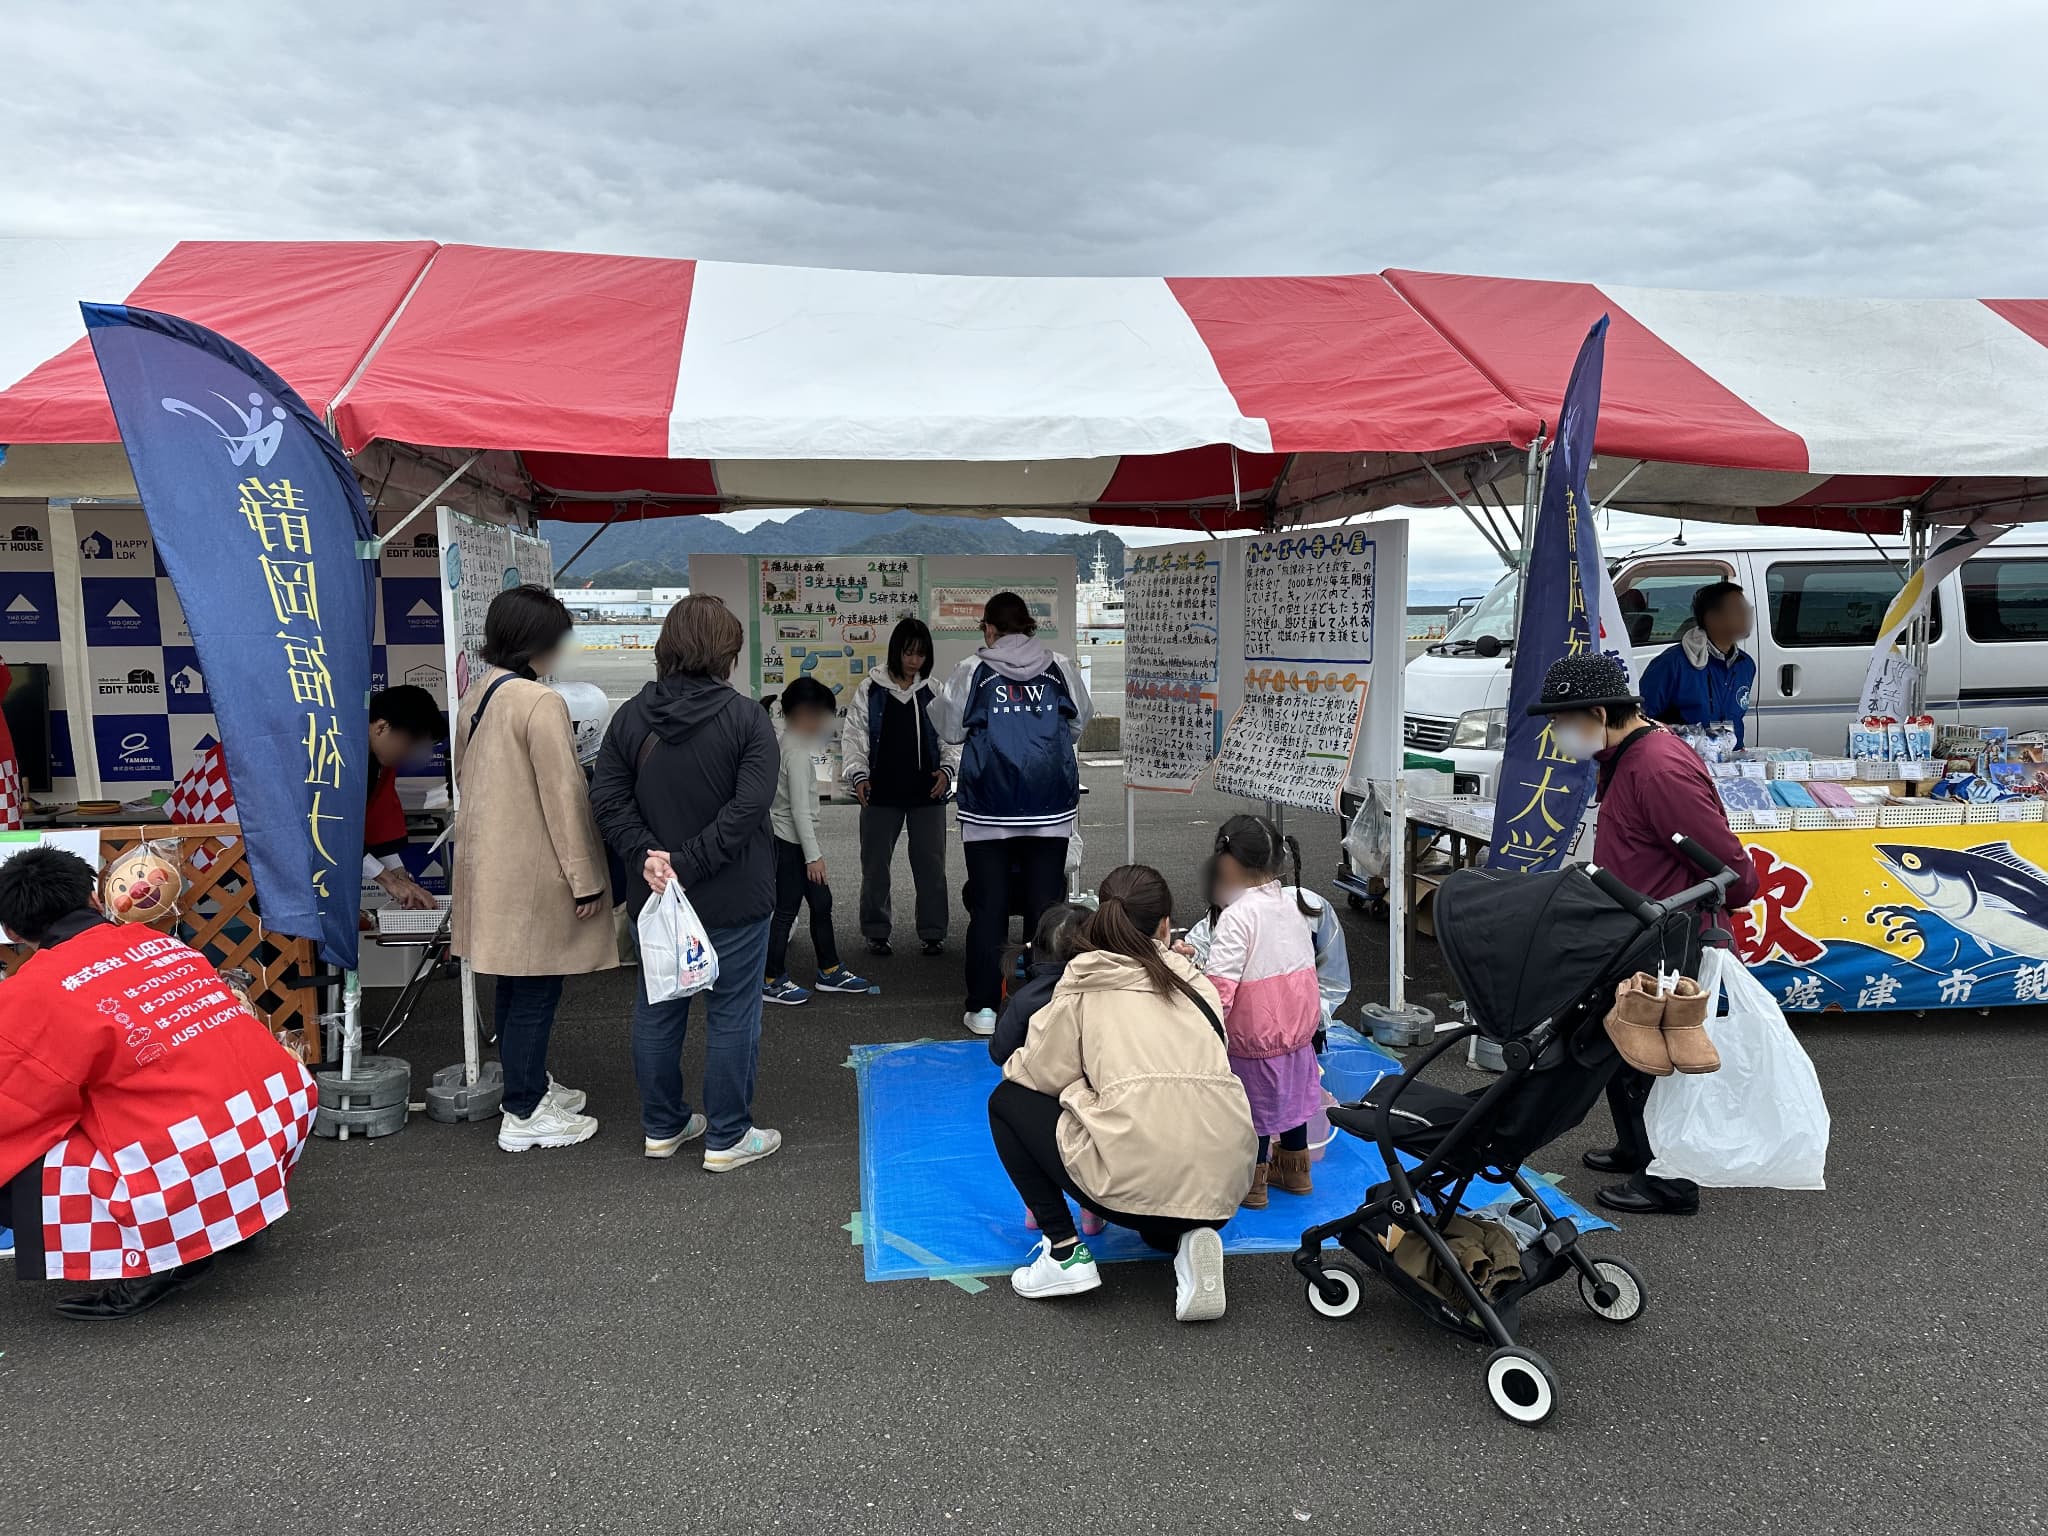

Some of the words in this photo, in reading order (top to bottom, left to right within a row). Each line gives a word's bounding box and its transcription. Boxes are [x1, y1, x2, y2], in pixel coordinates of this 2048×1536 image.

[11, 543, 43, 551] HOUSE
[115, 540, 148, 549] HAPPY
[116, 552, 136, 560] LDK
[387, 549, 409, 558] EDIT
[412, 549, 439, 558] HOUS
[770, 645, 777, 655] 6
[763, 655, 784, 667] 中庭
[99, 686, 123, 695] EDIT
[127, 685, 160, 694] HOUSE
[995, 684, 1045, 703] SUW
[61, 956, 128, 992] 株式会社
[171, 1022, 202, 1048] JUST
[202, 1006, 239, 1030] LUCKY
